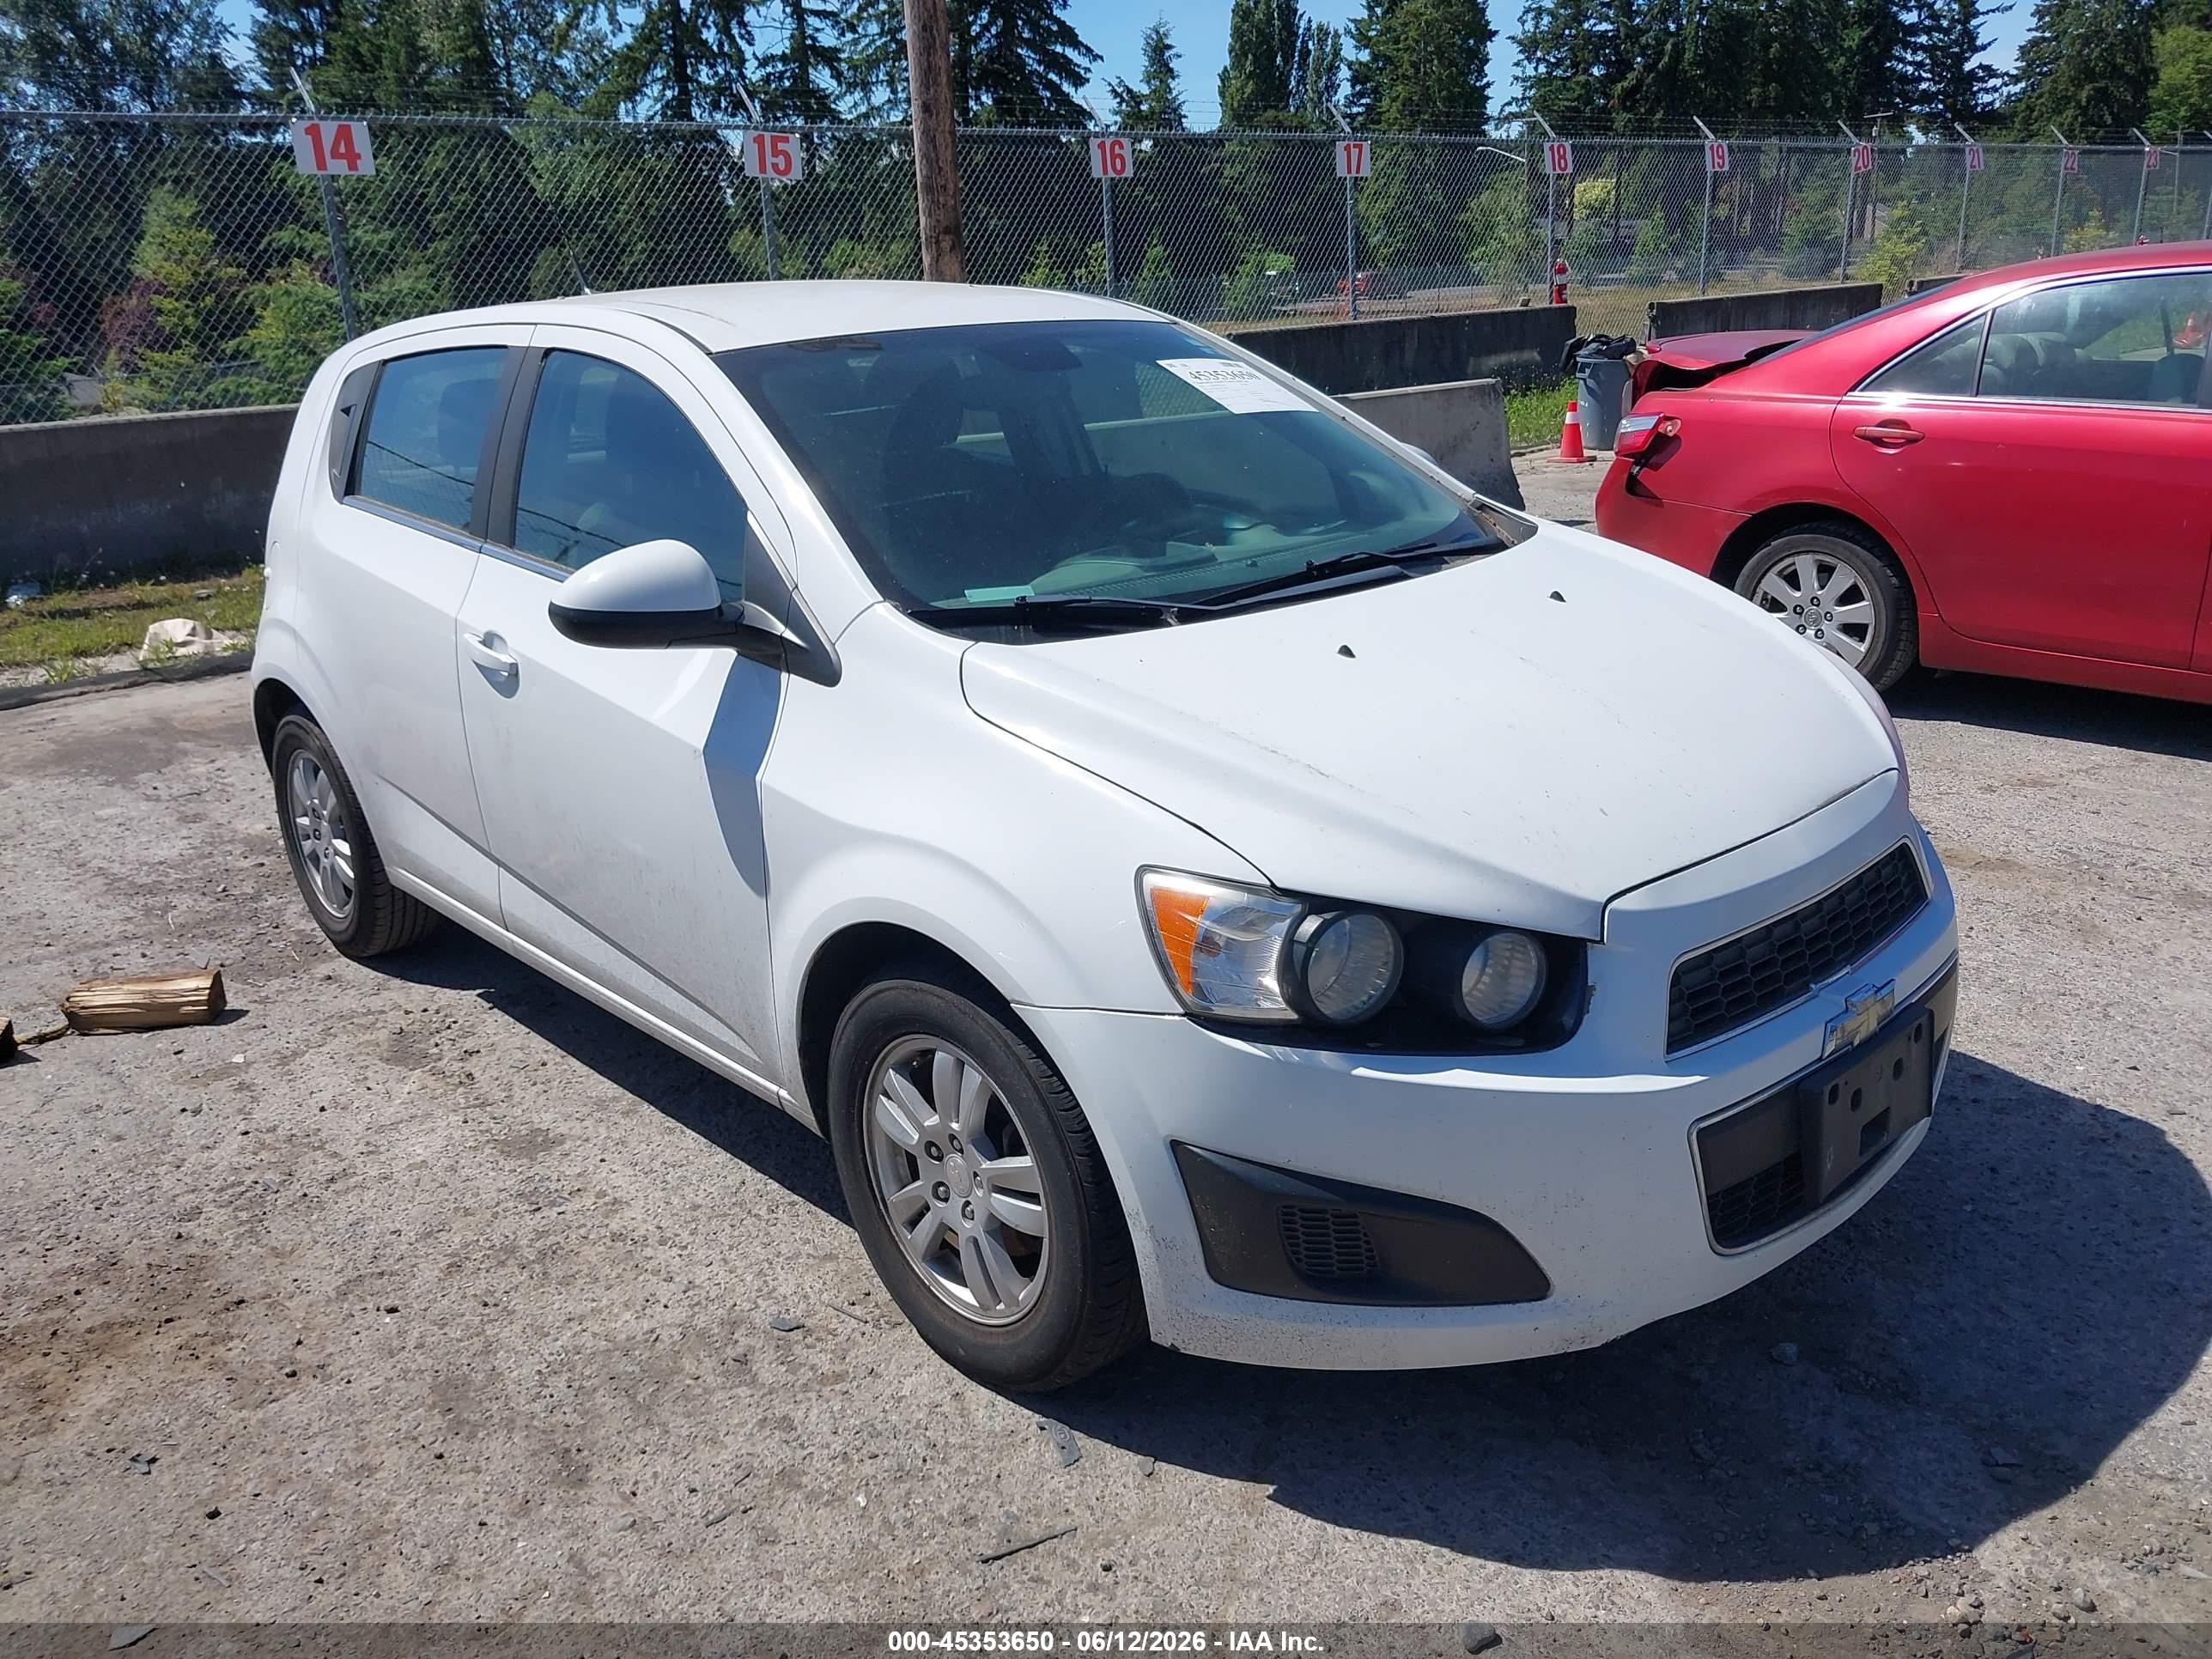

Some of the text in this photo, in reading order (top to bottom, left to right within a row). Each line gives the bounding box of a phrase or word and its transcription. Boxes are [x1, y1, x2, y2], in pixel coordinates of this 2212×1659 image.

[304, 123, 362, 172] 14
[752, 133, 793, 177] 15
[1097, 139, 1127, 176] 16
[1343, 143, 1364, 175] 17
[1548, 143, 1568, 173] 18
[1708, 143, 1726, 170] 19
[1853, 145, 1870, 173] 20
[1968, 147, 1981, 169] 21
[2063, 150, 2076, 171] 22
[2146, 149, 2159, 169] 23
